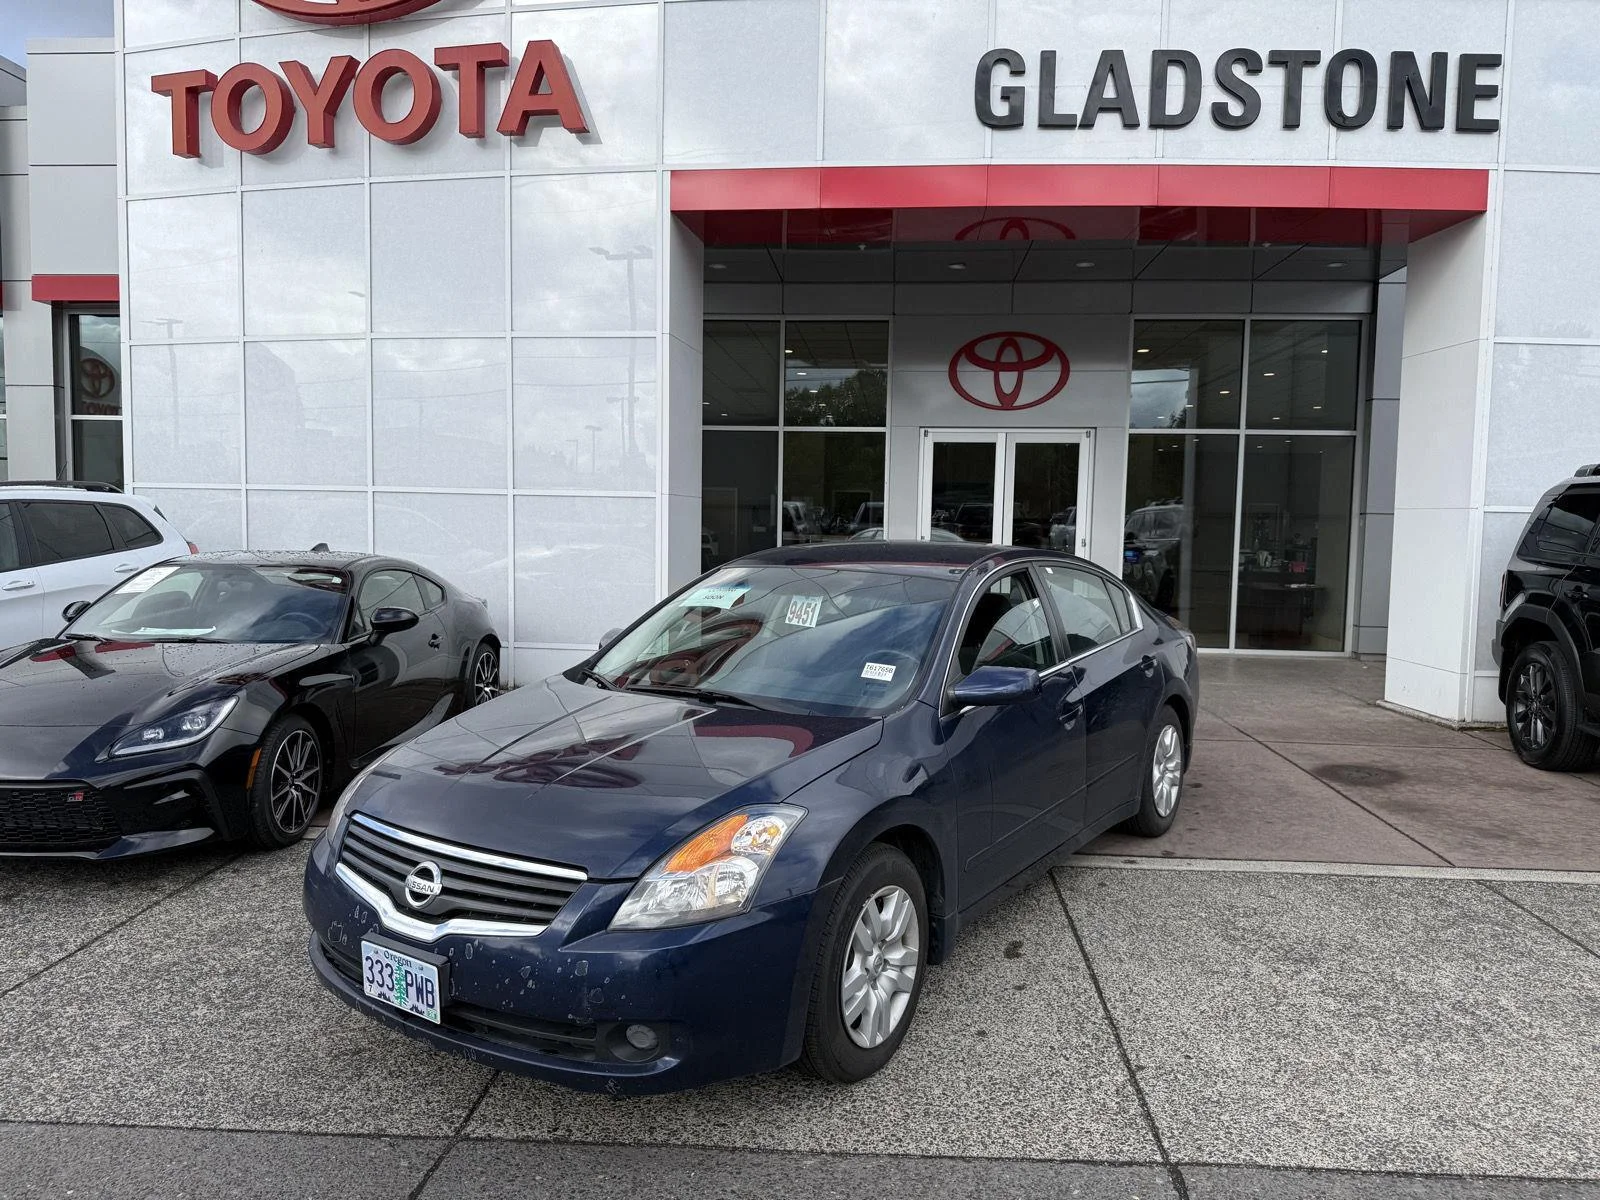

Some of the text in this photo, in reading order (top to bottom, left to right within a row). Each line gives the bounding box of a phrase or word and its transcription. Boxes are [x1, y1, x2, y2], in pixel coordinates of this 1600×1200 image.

[151, 39, 589, 159] TOYOTA
[974, 48, 1503, 133] GLADSTONE
[787, 600, 818, 626] 9451
[365, 955, 435, 1009] 333 PWB
[383, 950, 412, 968] Oregon
